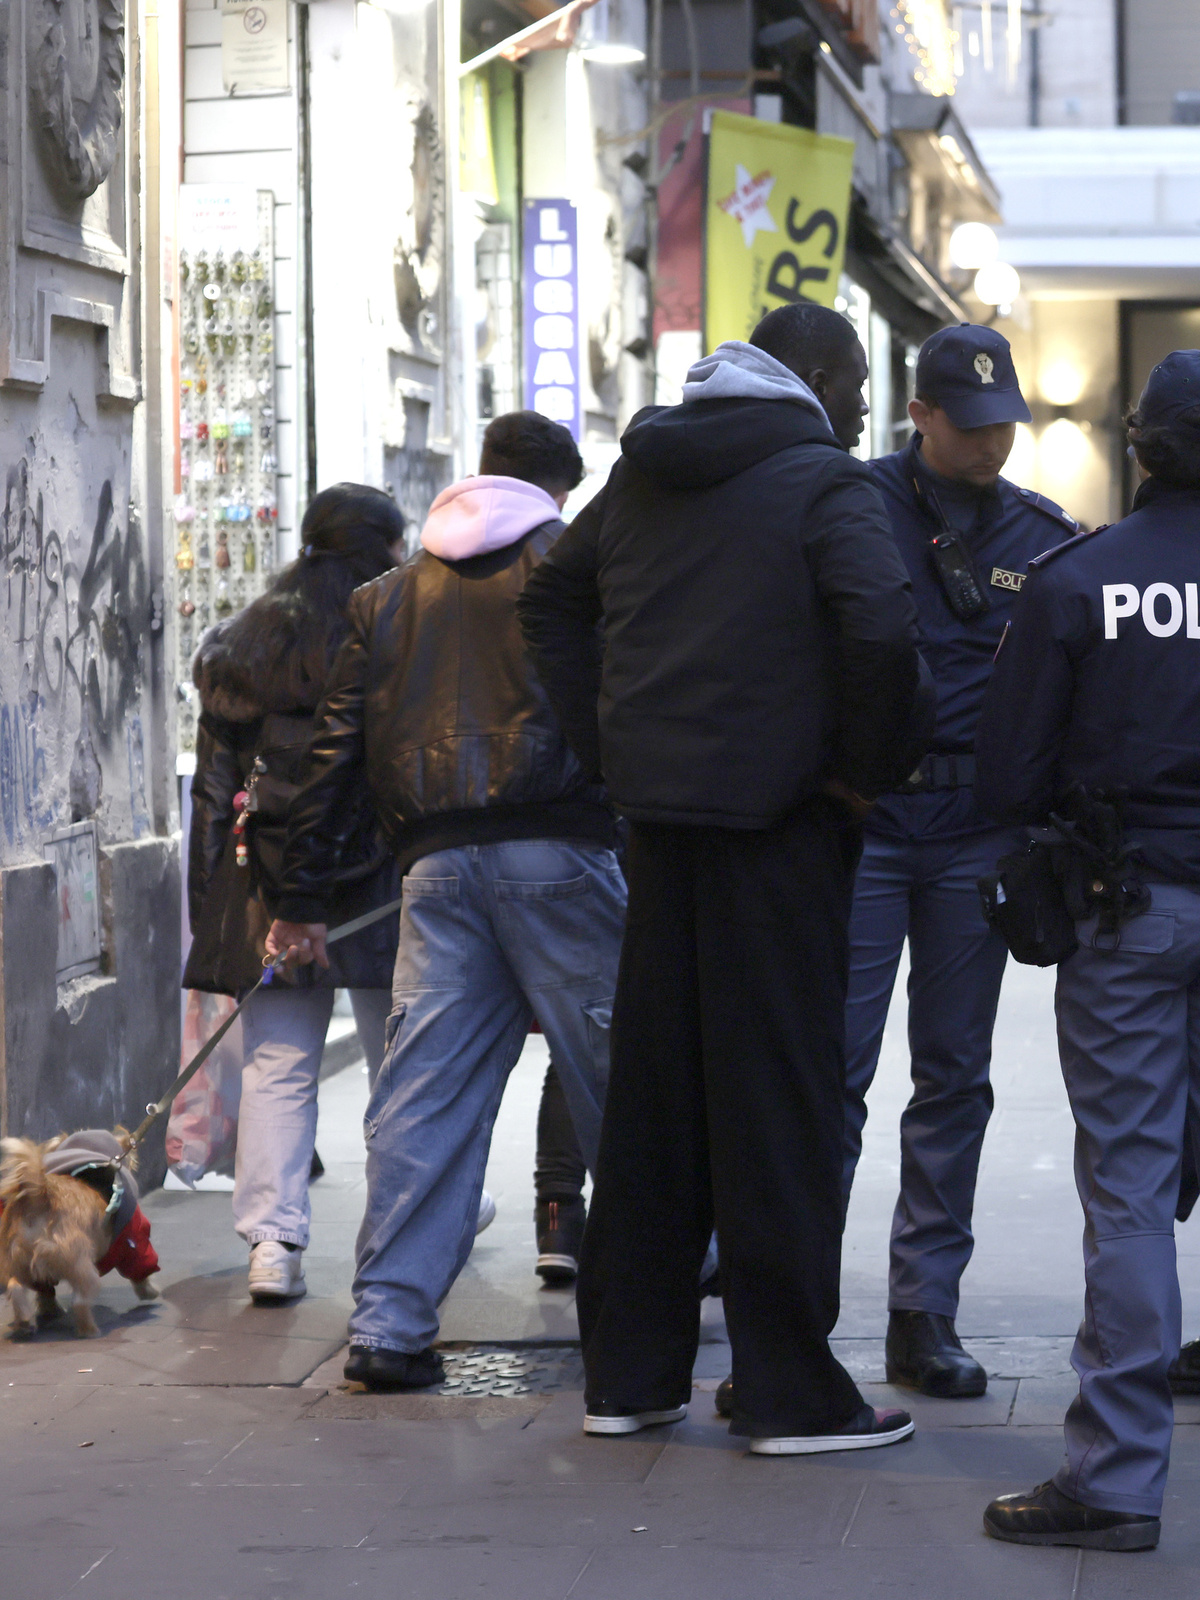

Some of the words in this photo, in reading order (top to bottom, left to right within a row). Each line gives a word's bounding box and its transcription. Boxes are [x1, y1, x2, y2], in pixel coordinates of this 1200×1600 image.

[762, 196, 838, 318] RS
[533, 208, 575, 429] LUGGAG
[993, 570, 1026, 589] POLI
